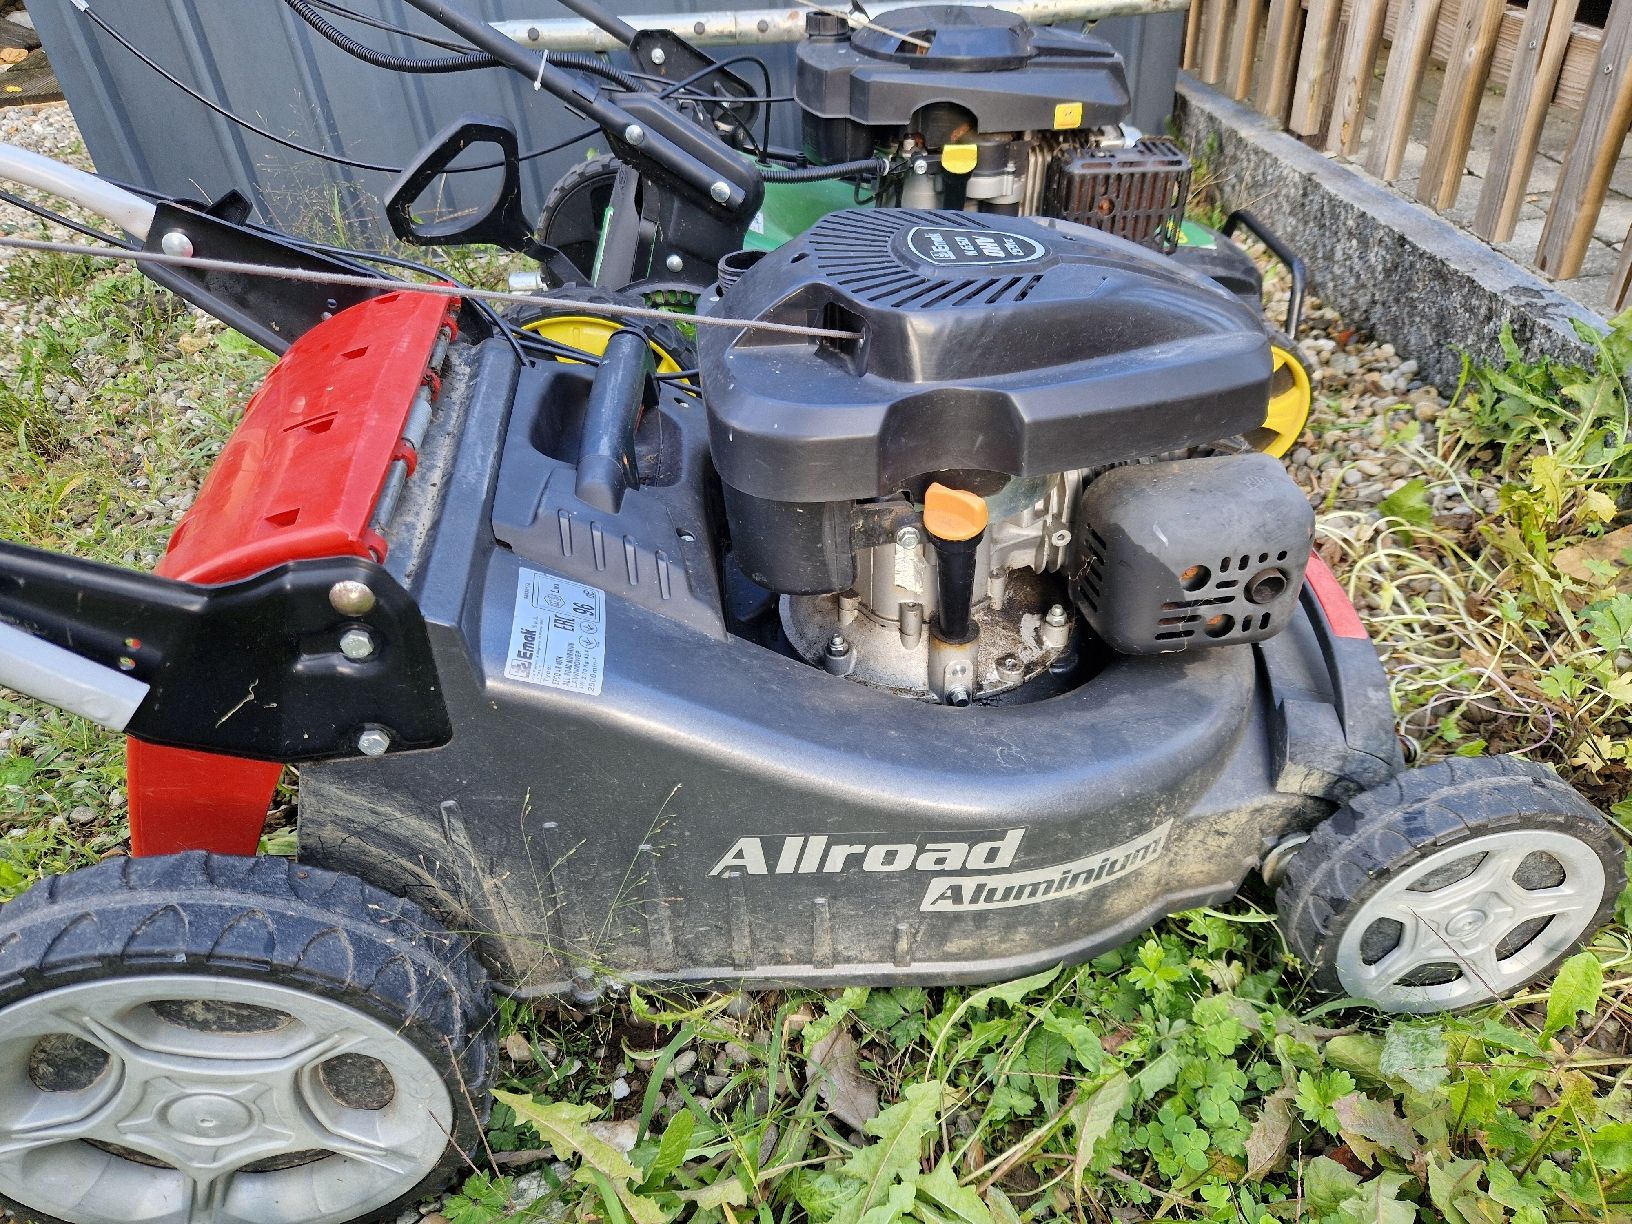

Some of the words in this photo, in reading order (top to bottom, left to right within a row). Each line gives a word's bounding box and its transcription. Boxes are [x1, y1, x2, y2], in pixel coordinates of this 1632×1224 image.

[573, 602, 595, 616] 96
[517, 628, 536, 660] Emak
[708, 828, 1026, 876] Allroad
[931, 837, 1160, 906] Aluminium
